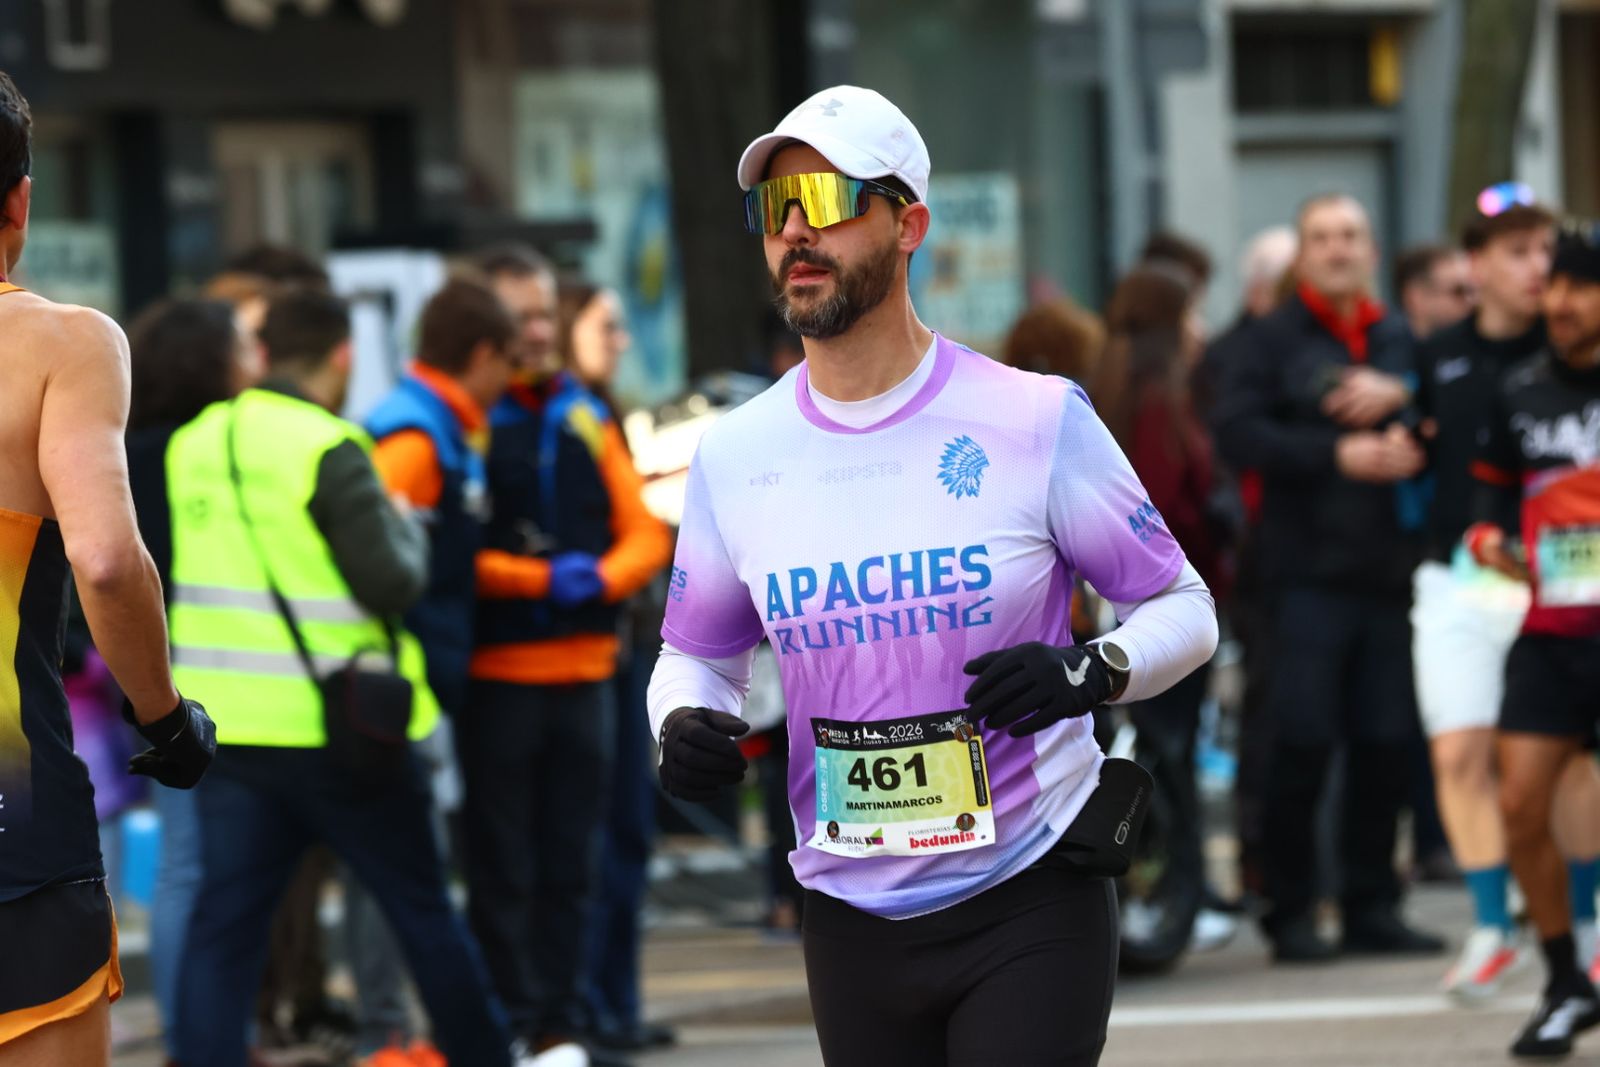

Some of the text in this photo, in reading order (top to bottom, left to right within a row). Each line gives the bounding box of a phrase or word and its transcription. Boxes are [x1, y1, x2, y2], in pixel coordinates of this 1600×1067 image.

[766, 544, 992, 622] APACHES
[774, 596, 993, 655] RUNNING
[888, 723, 924, 739] 2026
[847, 753, 928, 792] 461
[846, 796, 943, 811] MARTINAMARCOS
